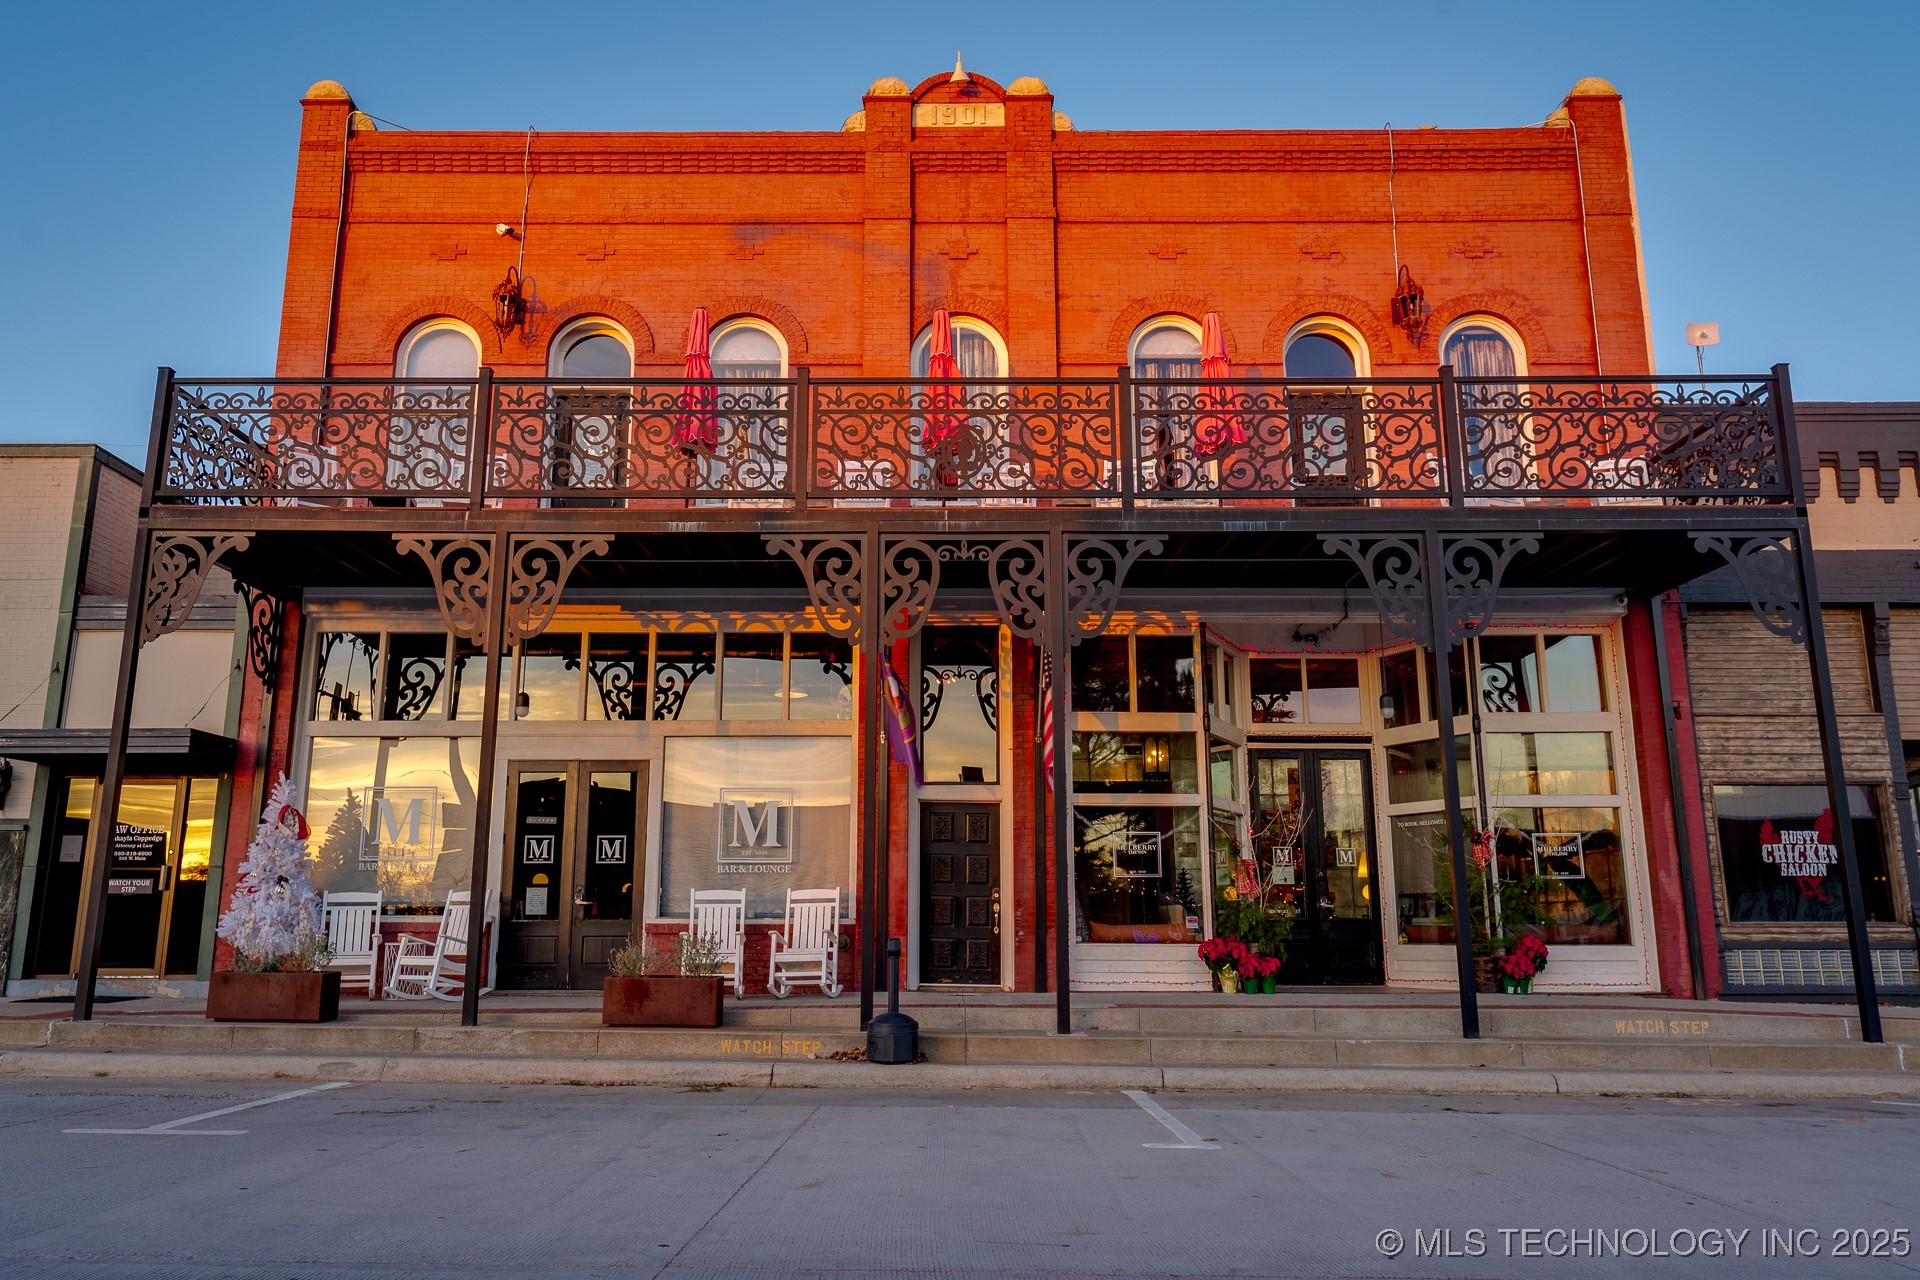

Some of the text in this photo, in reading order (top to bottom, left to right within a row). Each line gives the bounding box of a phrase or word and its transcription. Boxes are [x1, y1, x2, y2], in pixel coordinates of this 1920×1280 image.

[931, 105, 987, 125] 1901
[370, 798, 428, 845] M
[728, 800, 783, 847] M
[115, 824, 165, 834] AW OFFICE
[133, 835, 163, 843] Coppedge
[1780, 830, 1819, 845] RUSTY
[528, 839, 550, 859] M
[600, 839, 622, 859] M
[1276, 849, 1290, 862] M
[1339, 850, 1354, 863] M
[358, 862, 378, 871] BAR
[717, 864, 792, 873] BAR & LOUNGE
[1781, 863, 1828, 877] SALOON
[109, 879, 151, 887] WATCH YOUR
[1614, 1019, 1710, 1035] WATCH STEP
[721, 1039, 821, 1056] WATCH STEP
